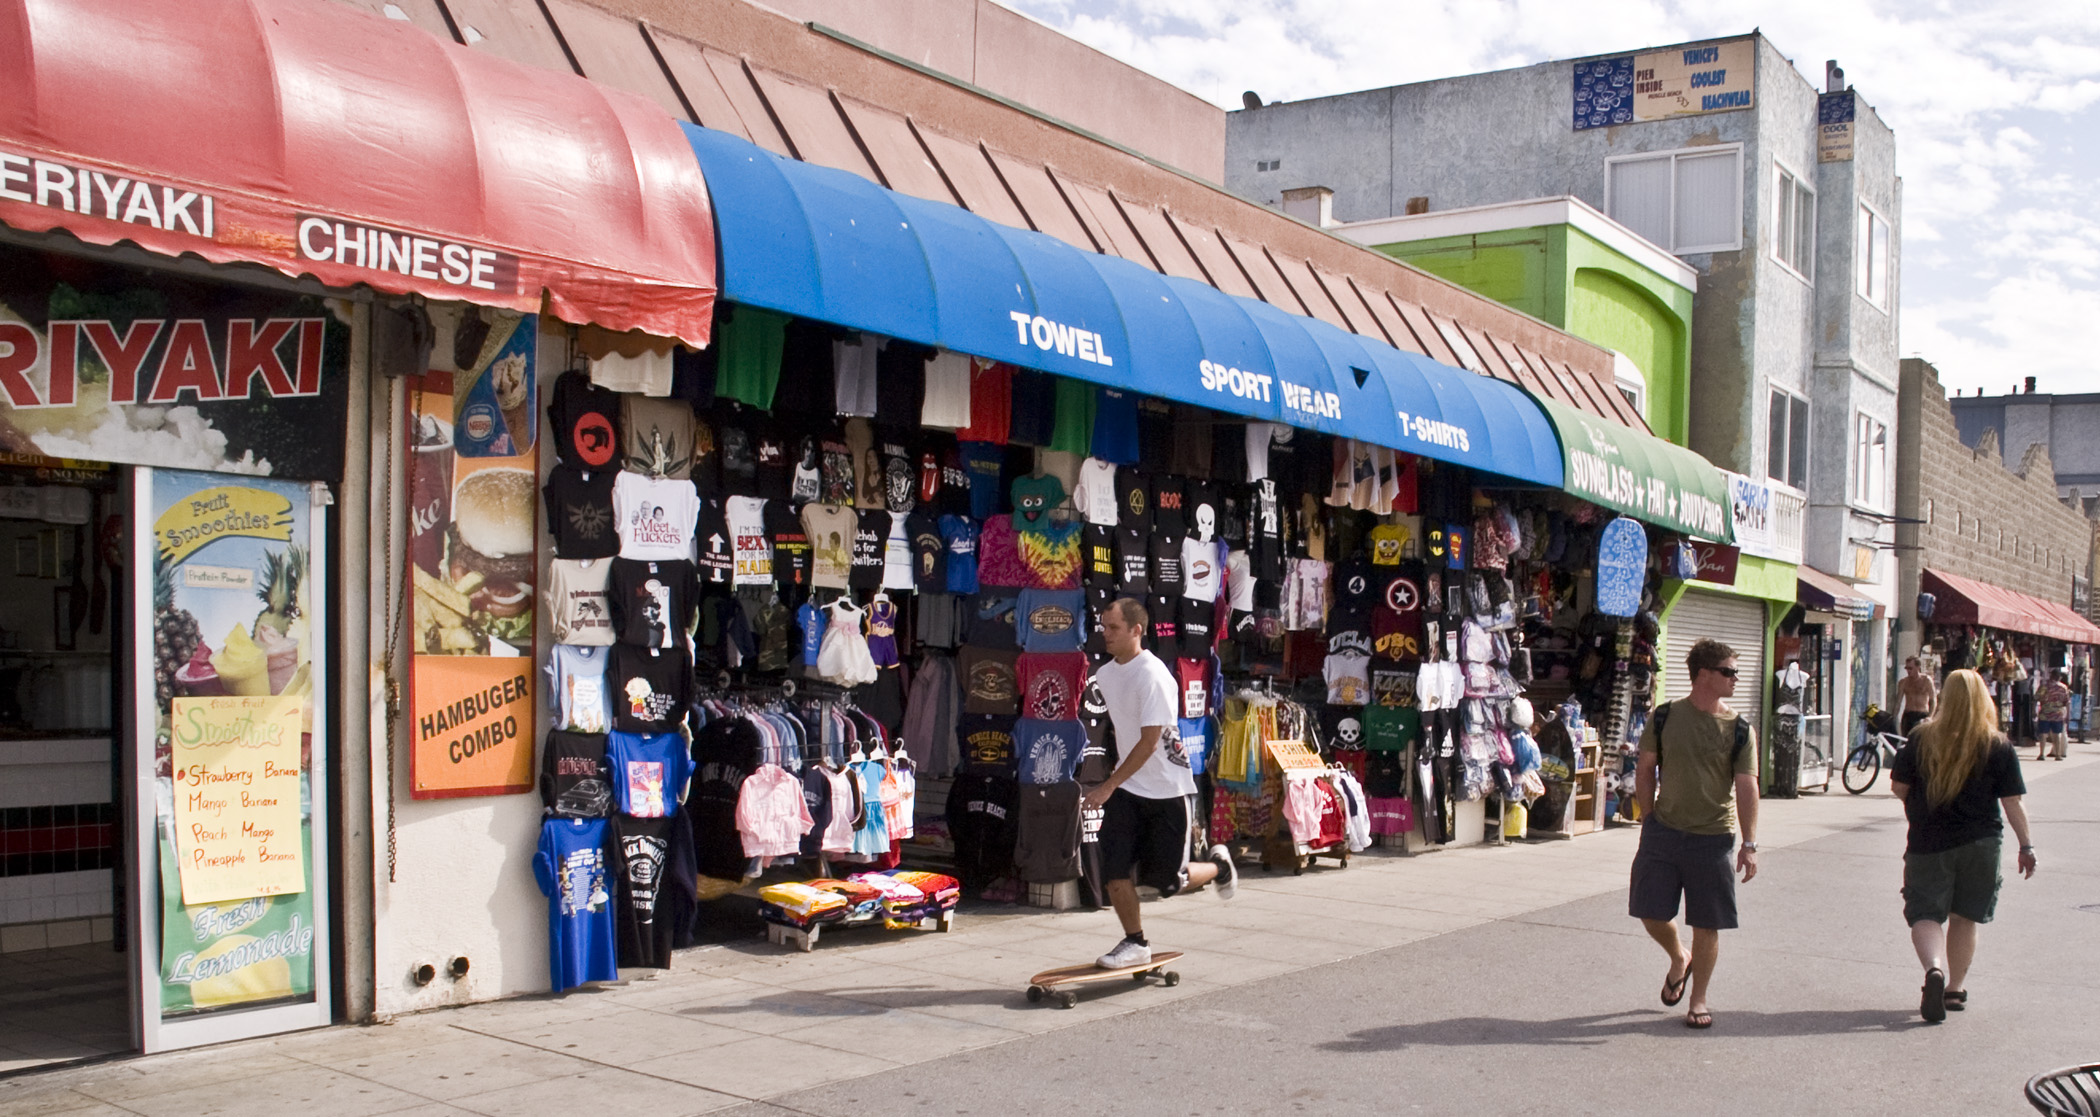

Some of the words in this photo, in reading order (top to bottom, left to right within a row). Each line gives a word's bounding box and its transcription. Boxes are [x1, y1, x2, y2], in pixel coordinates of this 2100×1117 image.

[1636, 68, 1655, 82] PIER
[1636, 80, 1663, 94] INSIDE
[1690, 69, 1727, 89] COOLEST
[1701, 90, 1751, 111] BEACHWEAR
[1823, 124, 1849, 133] COOL
[0, 151, 214, 239] ERIYAKI
[298, 217, 498, 290] CHINESE
[1010, 310, 1114, 367] TOWEL
[1198, 358, 1273, 403] SPORT
[1280, 379, 1342, 421] WEAR
[1398, 411, 1470, 453] T-SHIRTS
[1570, 447, 1635, 508] SUNGLASS
[1646, 476, 1666, 517] HAT
[191, 493, 230, 517] Fruit
[166, 509, 270, 548] Smoothies
[633, 527, 681, 544] Fuckers
[640, 519, 669, 533] Meet
[857, 529, 878, 541] ehab
[863, 542, 877, 552] for
[1697, 546, 1726, 572] Ban
[1375, 633, 1418, 655] USC
[420, 673, 529, 741] HAMBUGER
[449, 715, 518, 765] COMBO
[186, 764, 253, 786] Strawberry
[265, 760, 298, 779] Banana
[189, 791, 228, 817] Mango
[240, 790, 278, 808] Banana
[191, 822, 228, 843] Peach
[241, 820, 275, 842] Mango
[193, 848, 246, 871] Pineapple
[258, 845, 296, 864] Banana
[625, 842, 640, 858] ACK
[193, 895, 267, 942] Fresh
[167, 913, 313, 984] Lemonade
